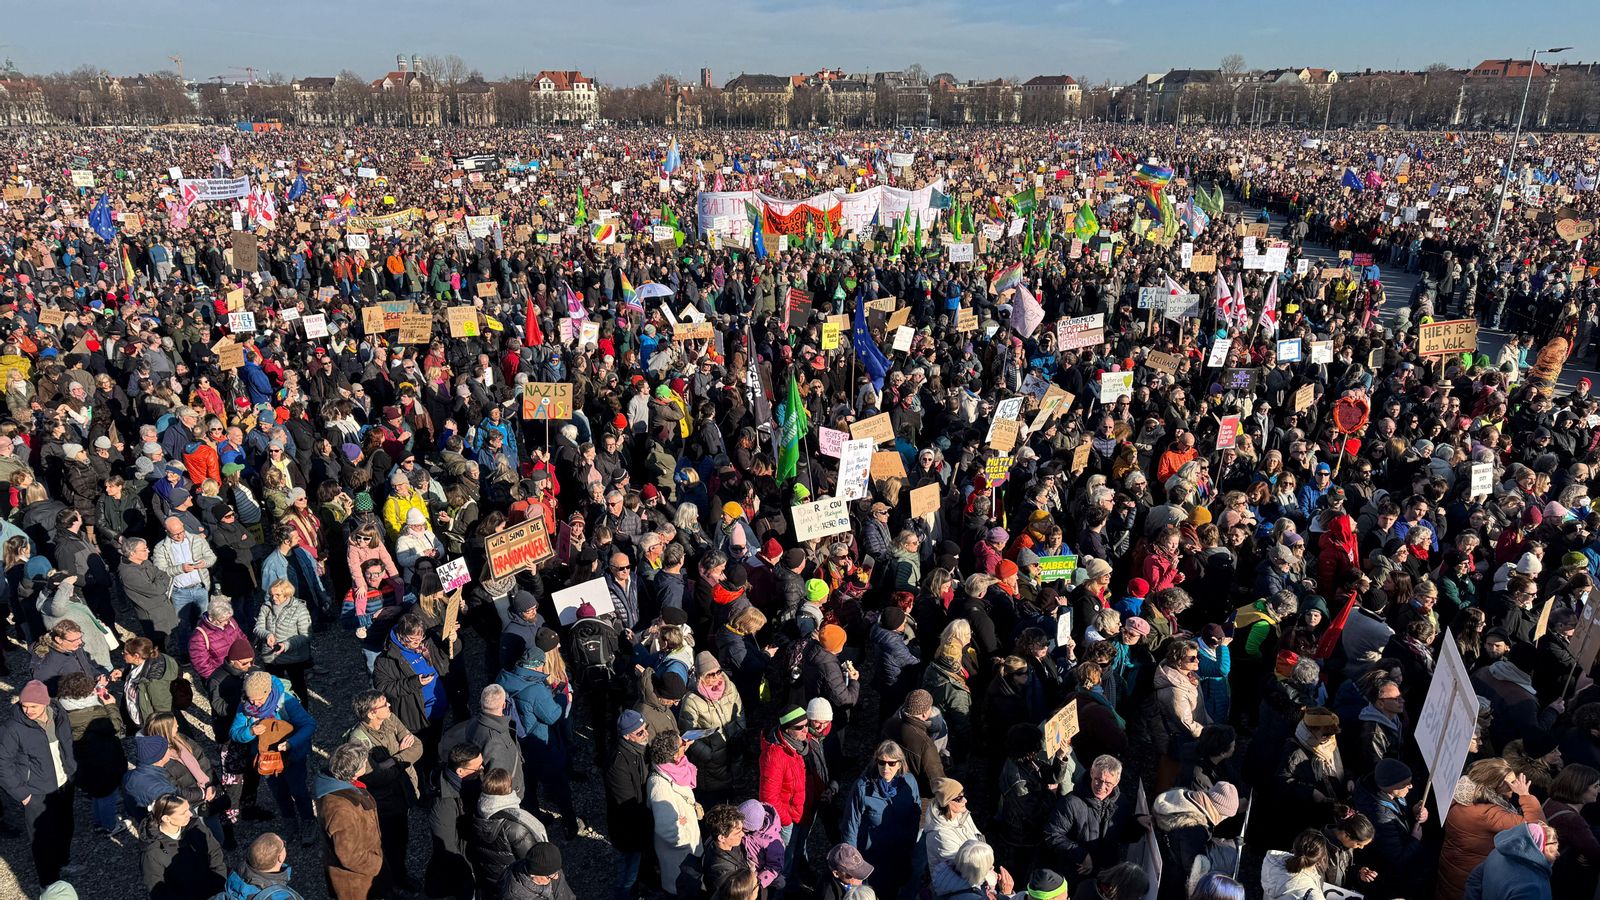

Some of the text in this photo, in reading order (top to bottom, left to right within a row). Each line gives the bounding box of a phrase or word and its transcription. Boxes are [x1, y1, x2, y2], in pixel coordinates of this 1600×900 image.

[1058, 316, 1095, 327] FASCHISMUS
[1058, 324, 1089, 335] STOPPEN
[1424, 326, 1451, 339] HIER
[1059, 332, 1078, 341] NICHT
[1425, 339, 1465, 351] das Volk
[988, 456, 1014, 467] MUTTI
[814, 504, 820, 512] R
[830, 501, 842, 509] CDU
[491, 523, 541, 548] WIR SIND DIE
[493, 534, 548, 574] BRANDMAUER!
[438, 562, 458, 576] ALICE
[1040, 560, 1076, 570] HABECK
